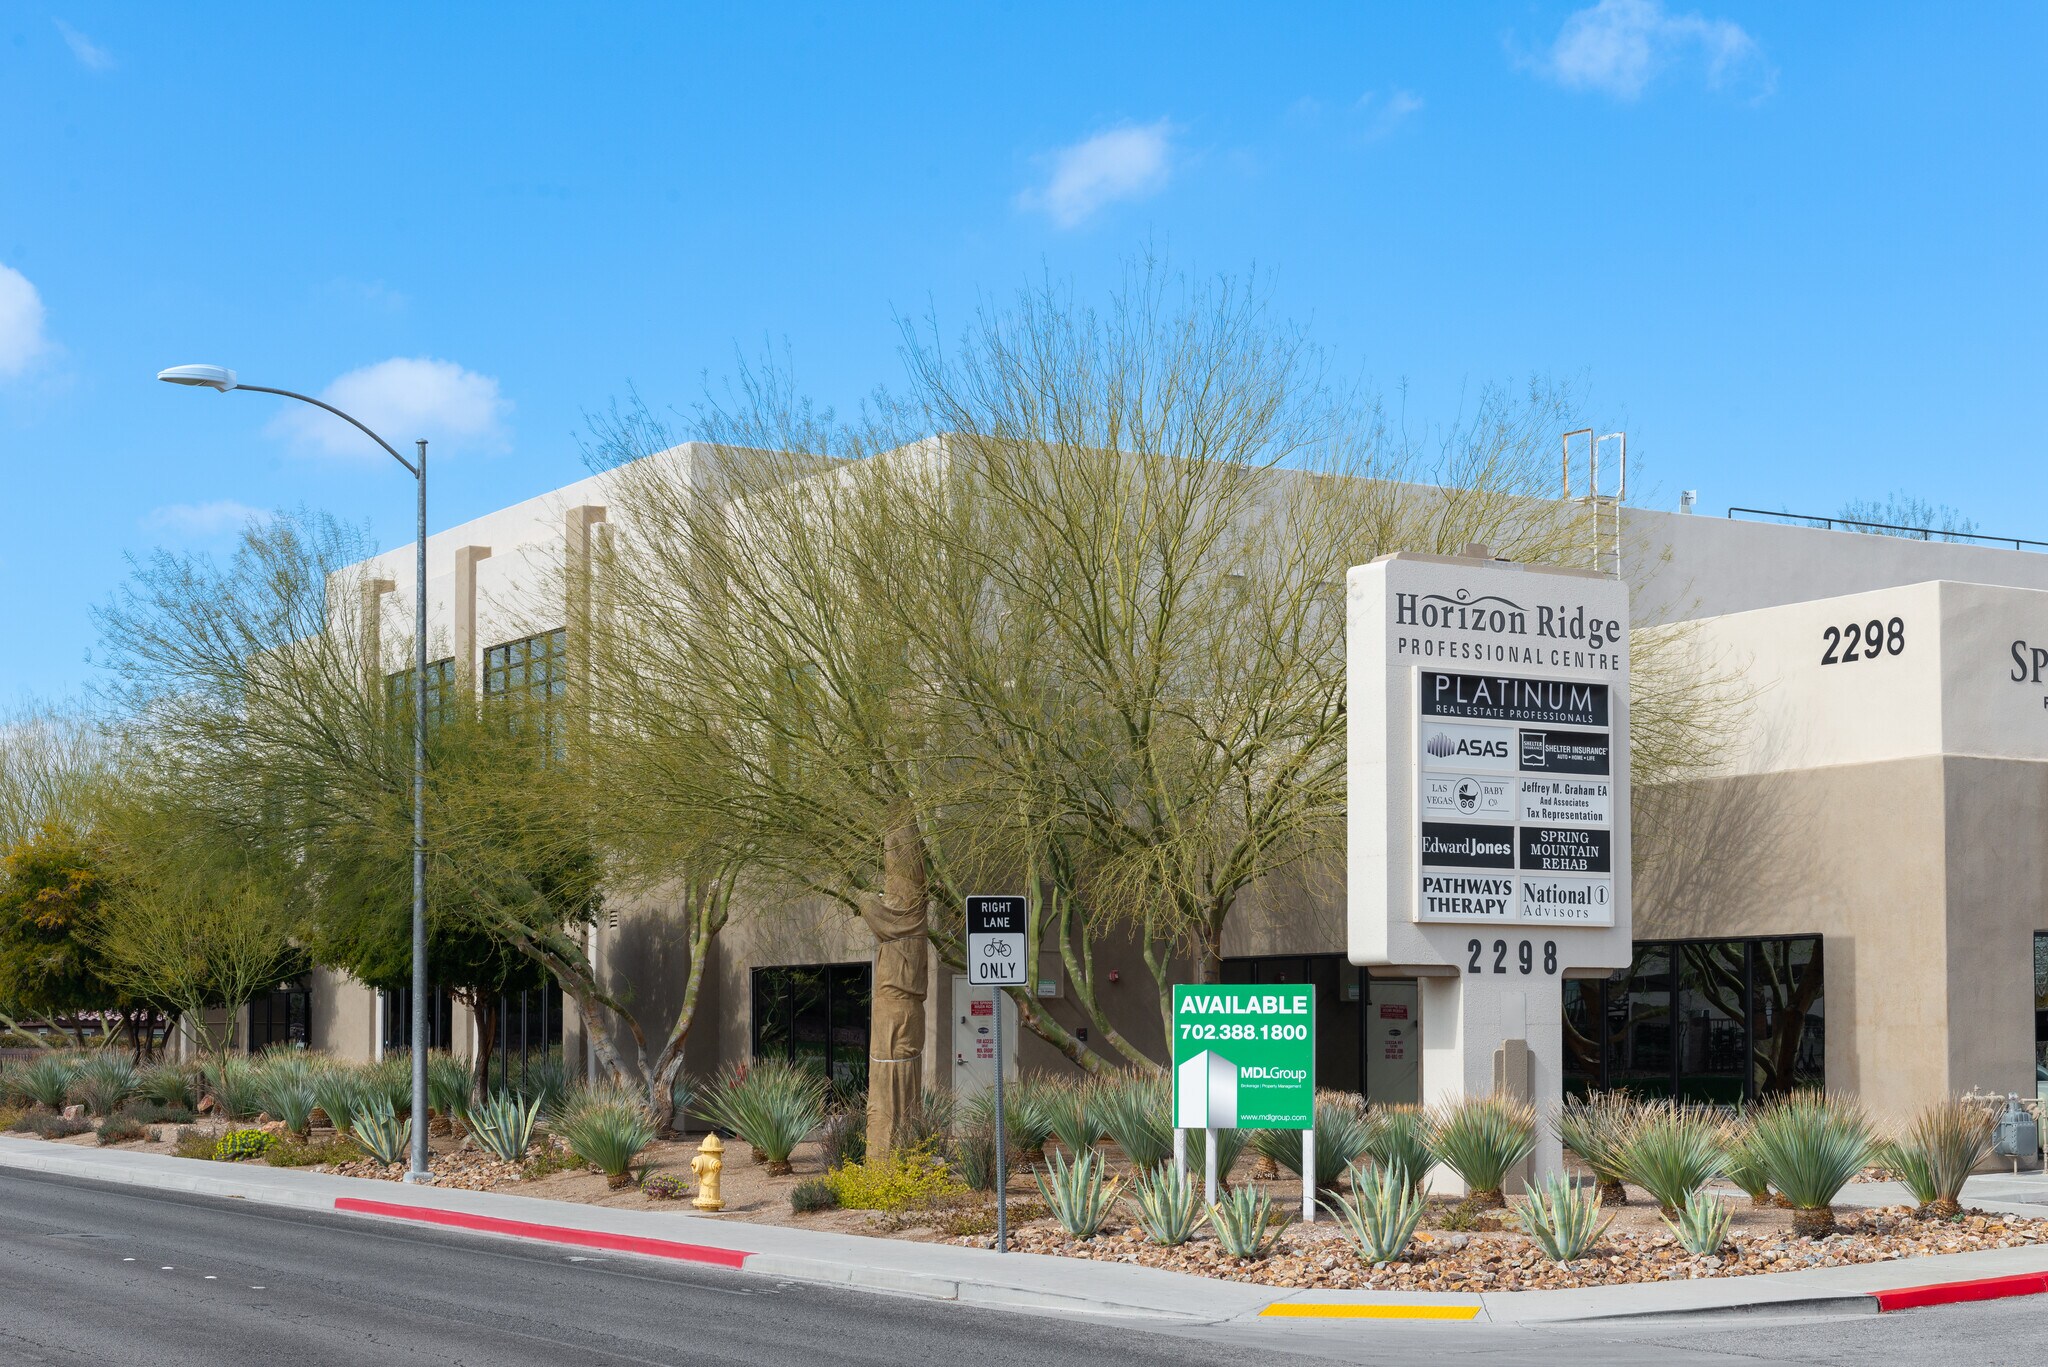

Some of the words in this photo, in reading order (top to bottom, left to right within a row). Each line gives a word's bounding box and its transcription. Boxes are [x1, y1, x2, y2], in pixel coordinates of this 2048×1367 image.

[1396, 592, 1528, 635] Horizon
[1536, 605, 1622, 649] Ridge
[1821, 617, 1905, 665] 2298
[1398, 638, 1544, 665] PROFESSIONAL
[1551, 649, 1620, 671] CENTRE
[1435, 675, 1593, 712] PLATINUM
[1436, 705, 1462, 714] REAL
[1467, 706, 1504, 717] ESTATE
[1510, 710, 1594, 723] PROFESSIONALS
[1456, 739, 1508, 758] ASAS
[1545, 744, 1571, 753] SHELTER
[1432, 784, 1448, 793] LAS
[1484, 787, 1504, 795] BABY
[1521, 781, 1550, 795] Jeffrey
[1552, 783, 1562, 794] M.
[1565, 784, 1595, 796] Graham
[1597, 785, 1608, 796] EA
[1426, 796, 1454, 805] VEGAS
[1540, 797, 1552, 806] And
[1553, 797, 1589, 807] Associates
[1526, 807, 1540, 818] Tax
[1542, 808, 1603, 821] Representation
[1540, 831, 1590, 844] SPRING
[1530, 843, 1600, 858] MOUNTAIN
[1542, 858, 1588, 871] REHAB
[1422, 877, 1513, 896] PATHWAYS
[1523, 883, 1592, 905] National
[981, 902, 1012, 913] RIGHT
[1427, 897, 1508, 915] THERAPY
[1523, 905, 1589, 918] Advisors
[983, 917, 1010, 928] LANE
[1467, 939, 1558, 975] 2298
[980, 963, 1016, 979] ONLY
[1180, 995, 1307, 1015] AVAILABLE
[1180, 1024, 1307, 1041] 702.388.1800
[1240, 1066, 1307, 1083] MDLGroup
[1240, 1113, 1307, 1122] www.mdlgroup.com
